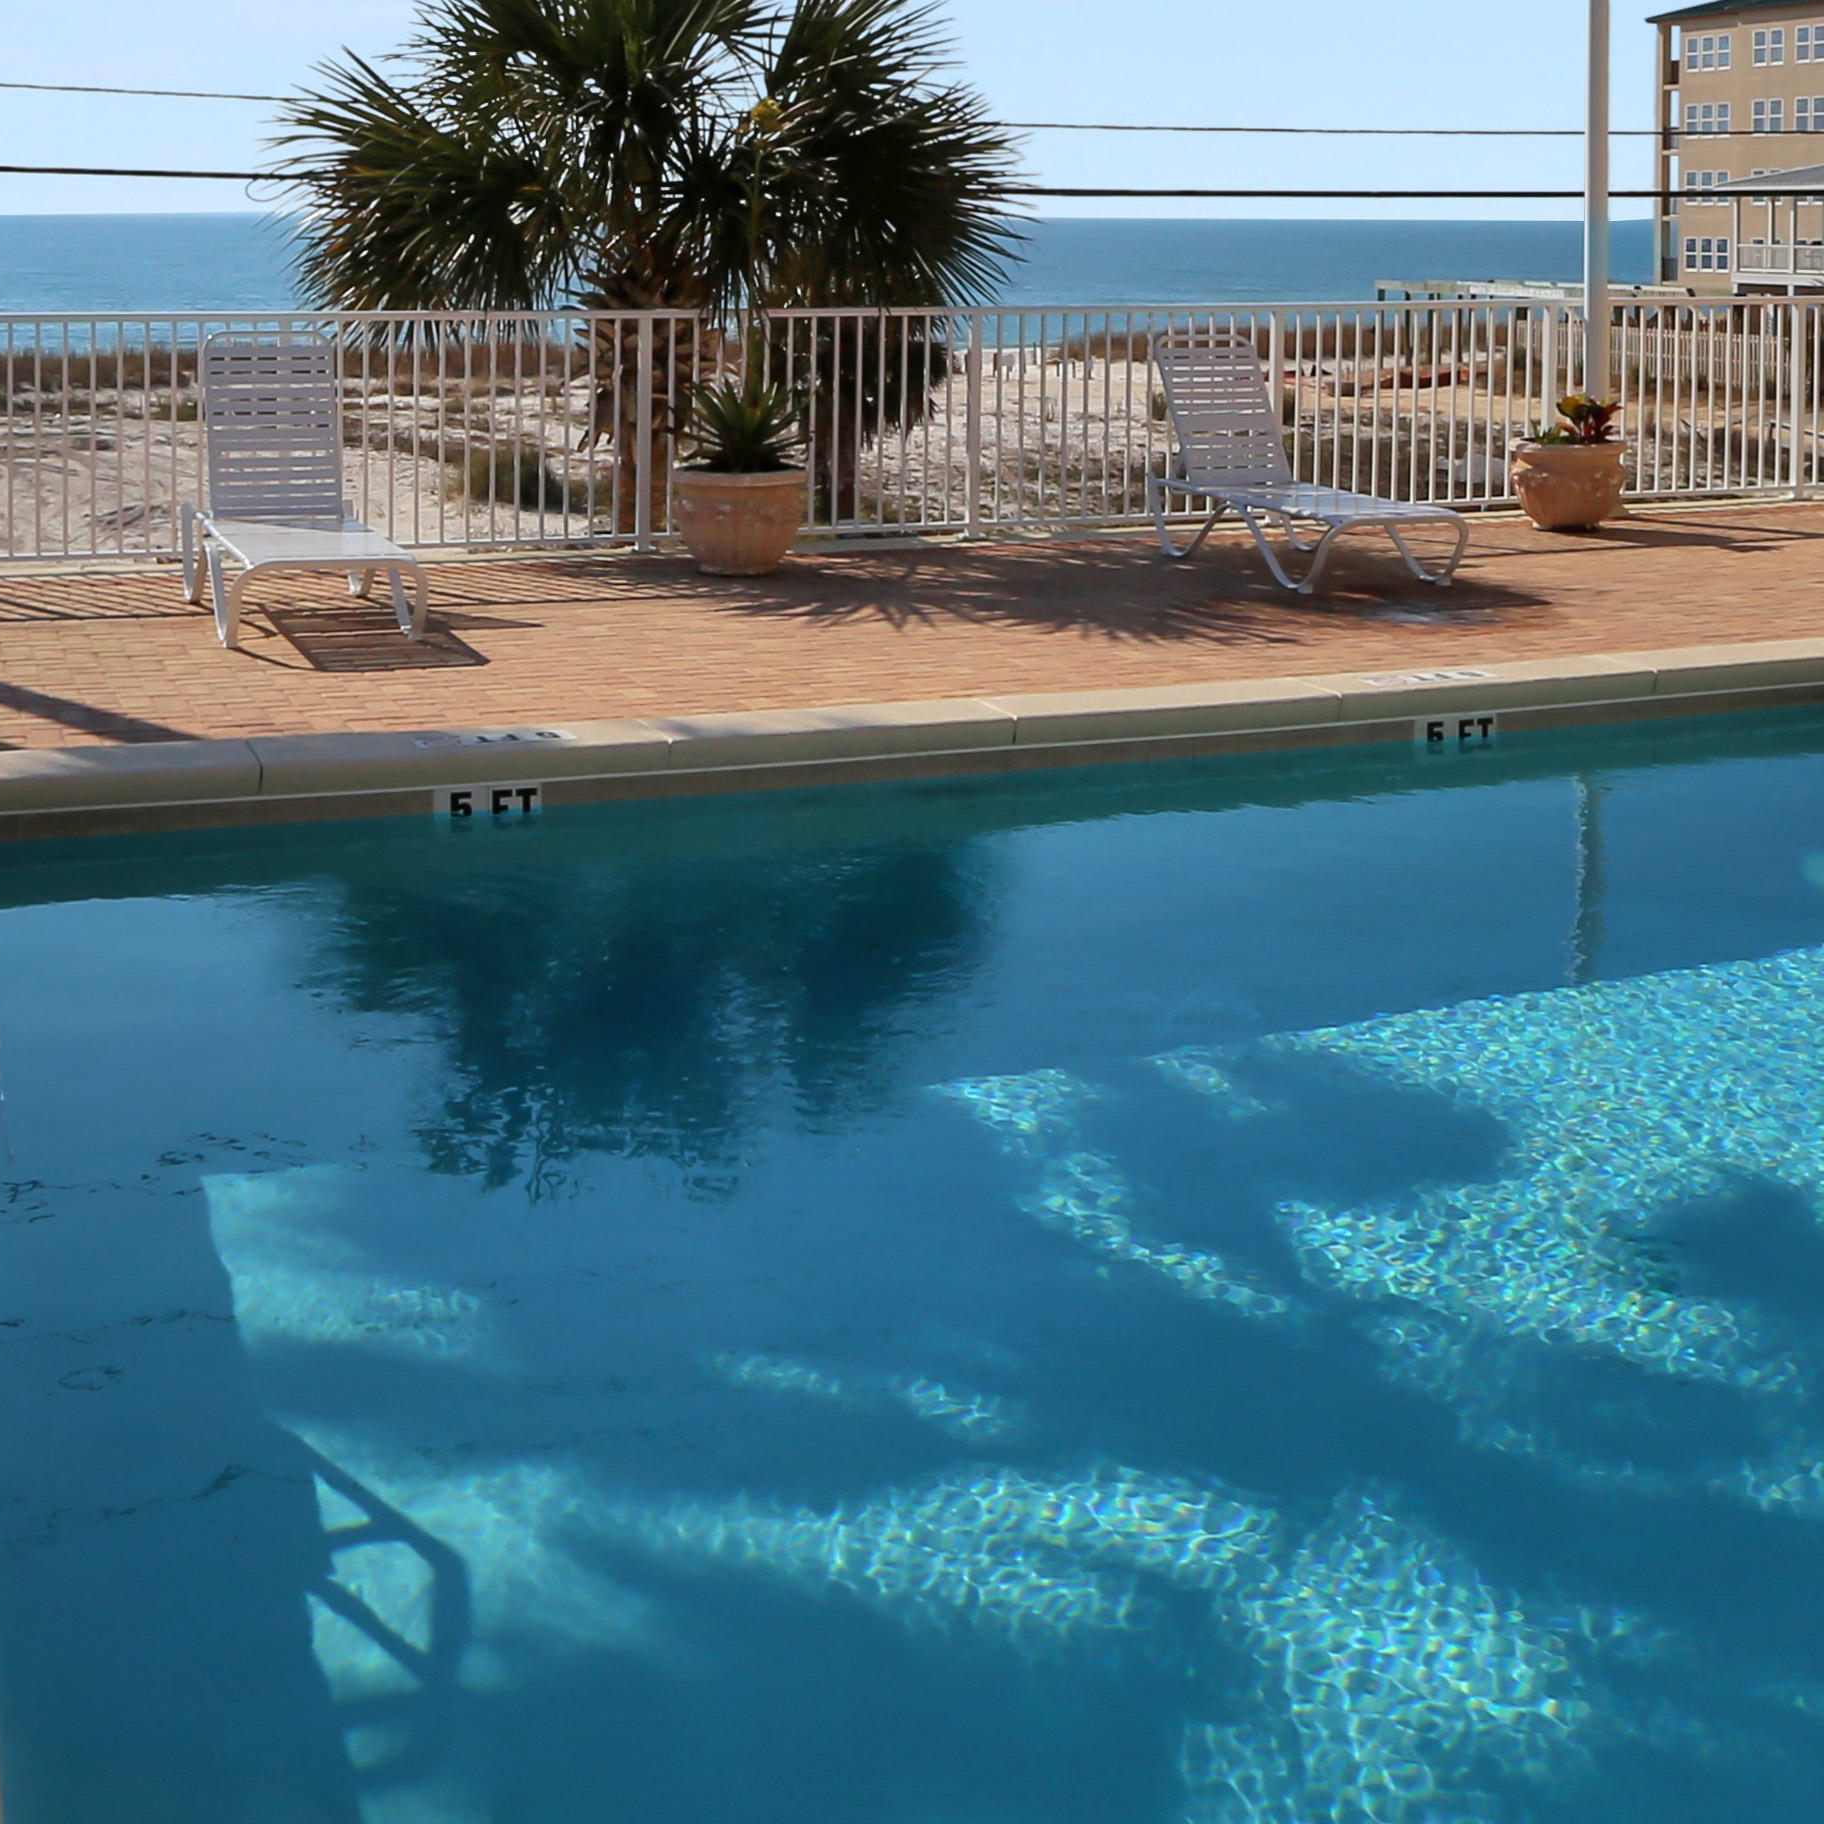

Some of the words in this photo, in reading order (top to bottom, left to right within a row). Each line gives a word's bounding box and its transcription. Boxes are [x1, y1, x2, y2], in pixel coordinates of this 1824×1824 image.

[1458, 717, 1493, 740] FT
[450, 791, 472, 817] 5
[491, 787, 538, 815] FT
